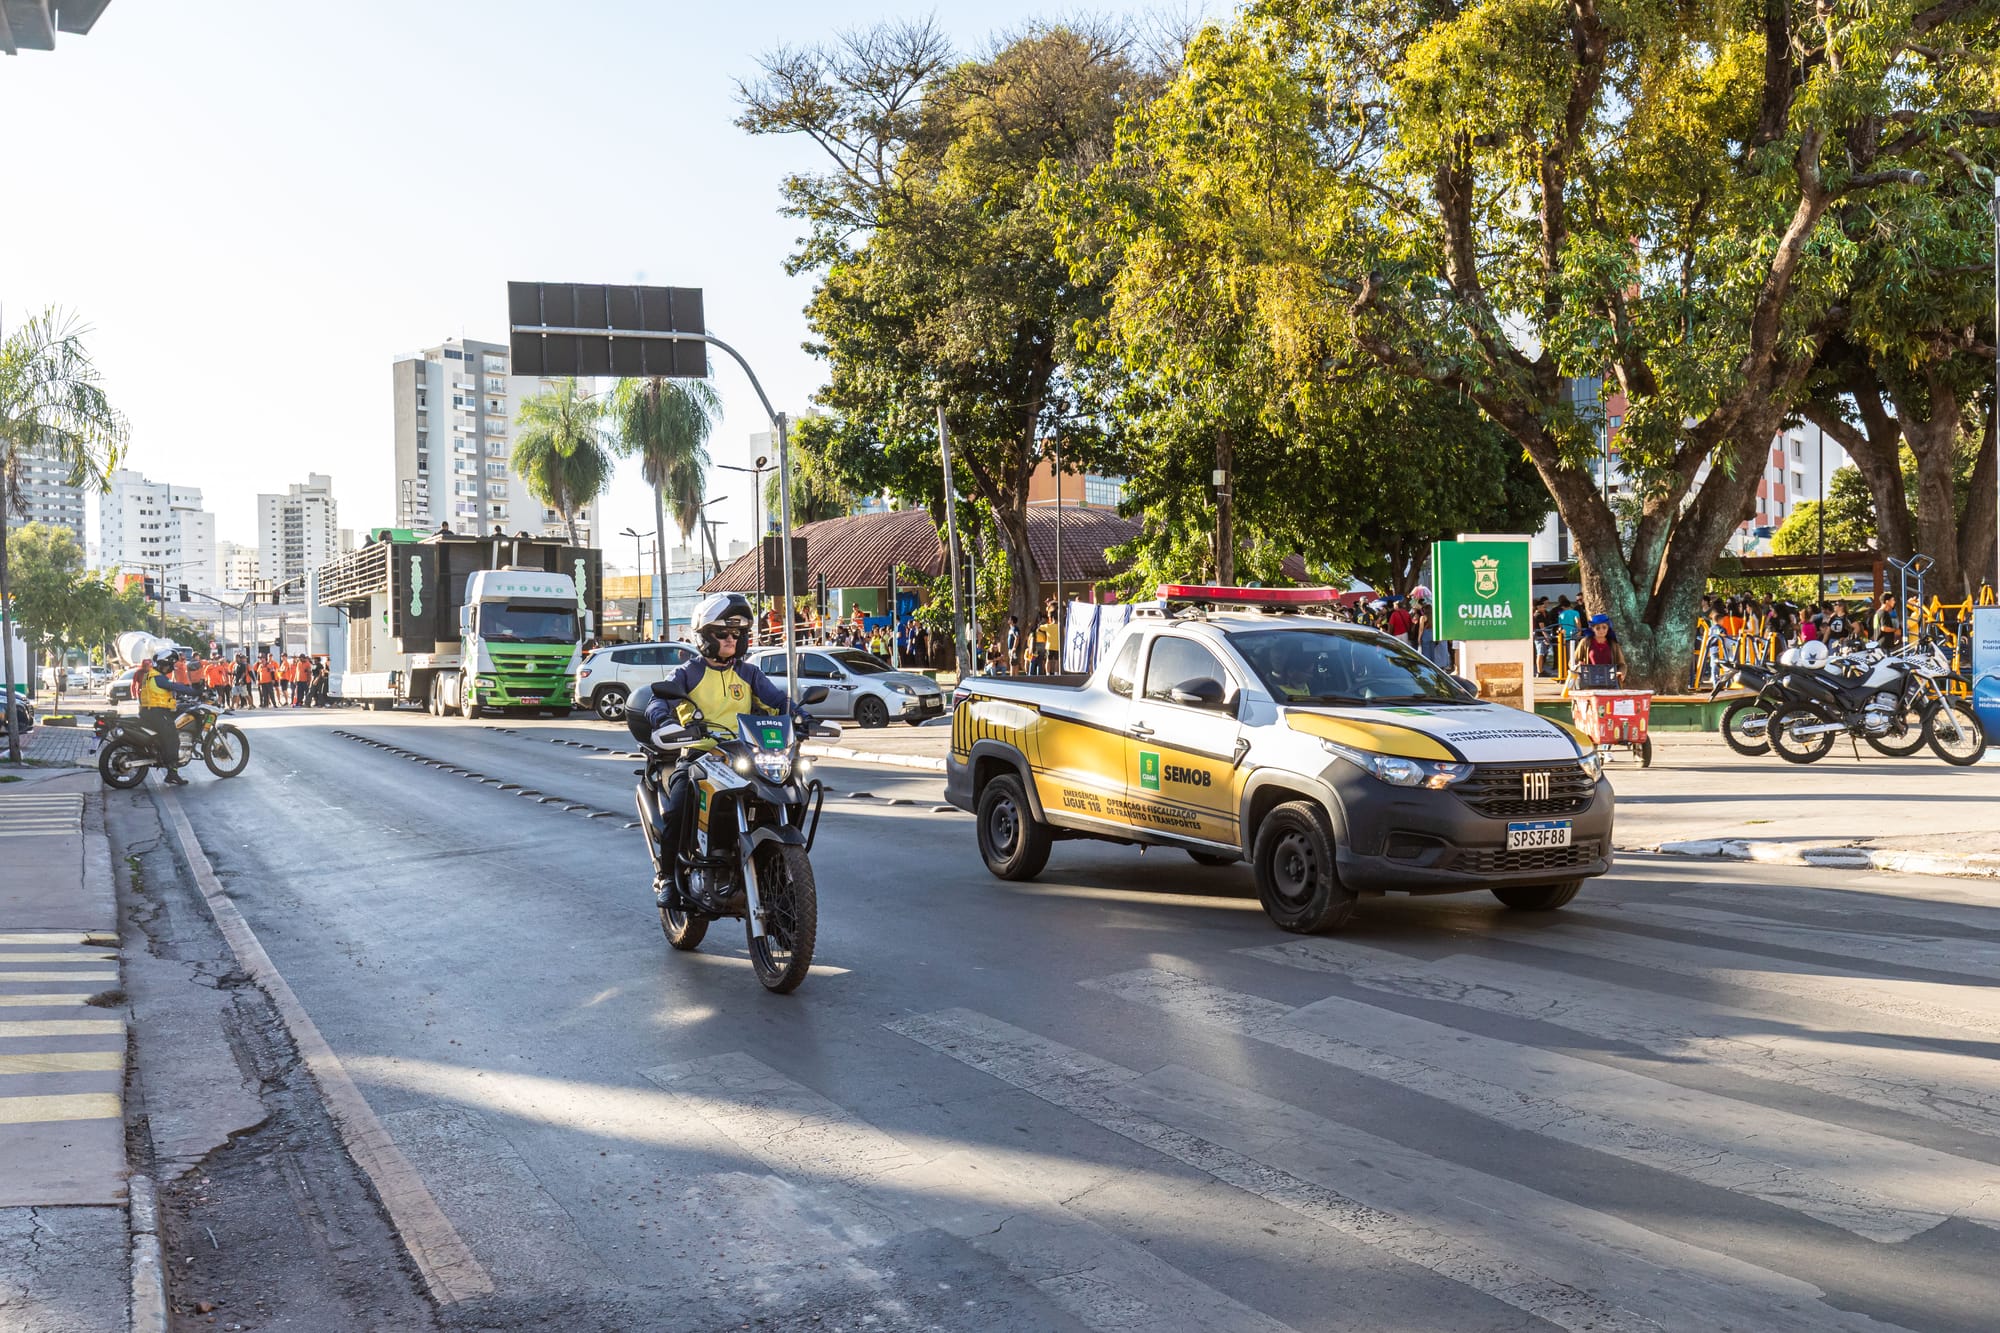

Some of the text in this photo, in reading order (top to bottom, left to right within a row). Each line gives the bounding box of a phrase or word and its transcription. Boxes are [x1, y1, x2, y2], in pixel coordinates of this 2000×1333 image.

[496, 585, 564, 594] TROVÃO
[1458, 601, 1512, 619] CUIABÁ
[1446, 729, 1489, 737] OPERAÇÃO
[1463, 733, 1501, 741] TRÂNSITO
[1164, 765, 1211, 787] SEMOB
[1063, 789, 1099, 801] EMERGÊNCIA
[1523, 773, 1551, 800] FIAT
[1063, 797, 1101, 813] LIGUE 118
[1107, 798, 1141, 812] OPERAÇÃO
[1147, 805, 1197, 820] FISCALIZAÇÃO
[1107, 807, 1115, 815] DE
[1116, 808, 1147, 822] TRÂNSITO
[1152, 815, 1202, 831] TRANSPORTES
[1513, 829, 1565, 847] SPS3F88
